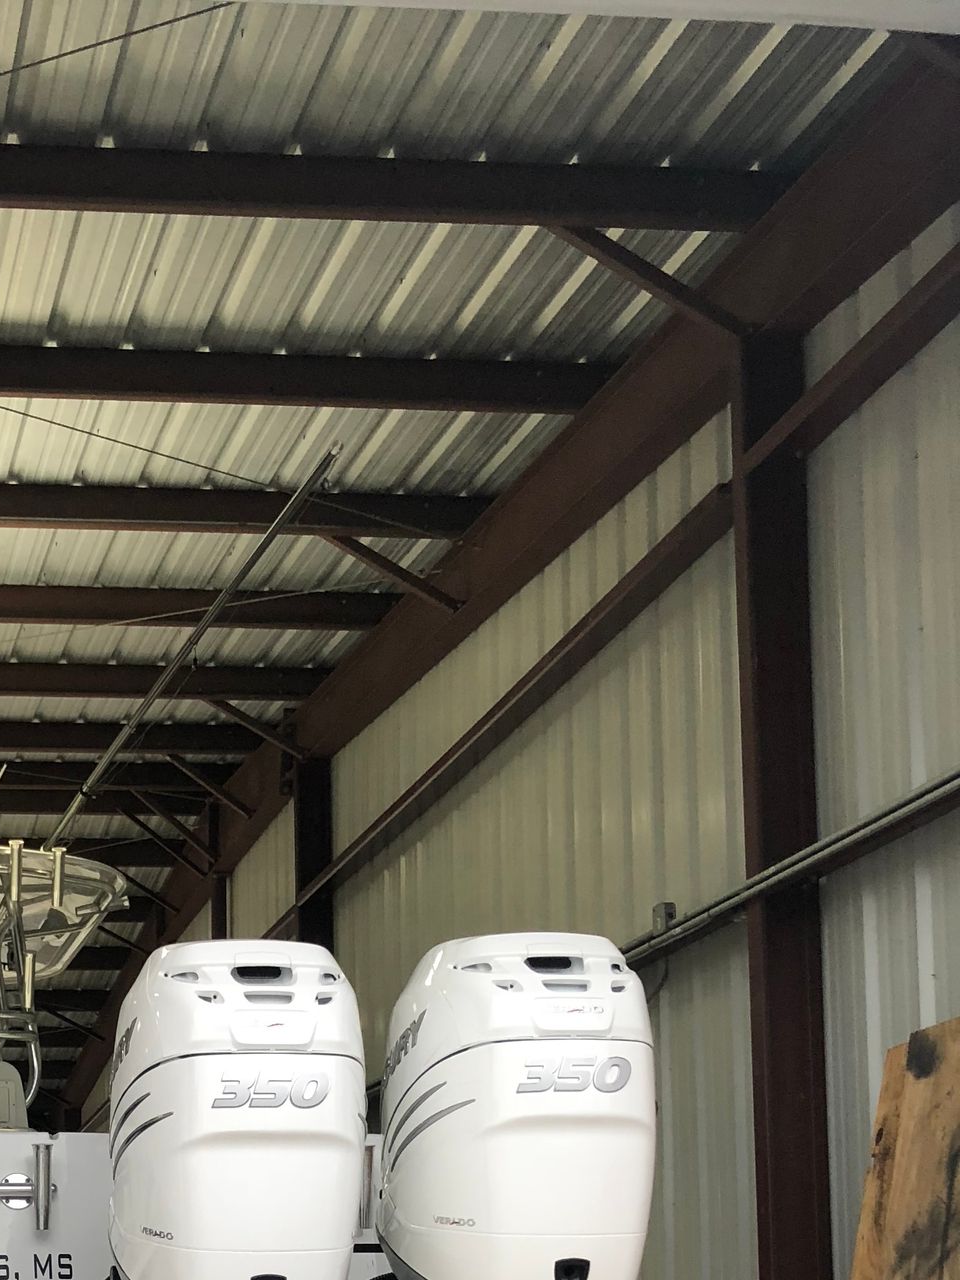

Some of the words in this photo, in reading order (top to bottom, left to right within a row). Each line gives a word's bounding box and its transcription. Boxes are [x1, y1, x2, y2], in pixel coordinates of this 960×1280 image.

[211, 1070, 331, 1109] 350
[516, 1055, 632, 1093] 350
[33, 1253, 73, 1280] MS
